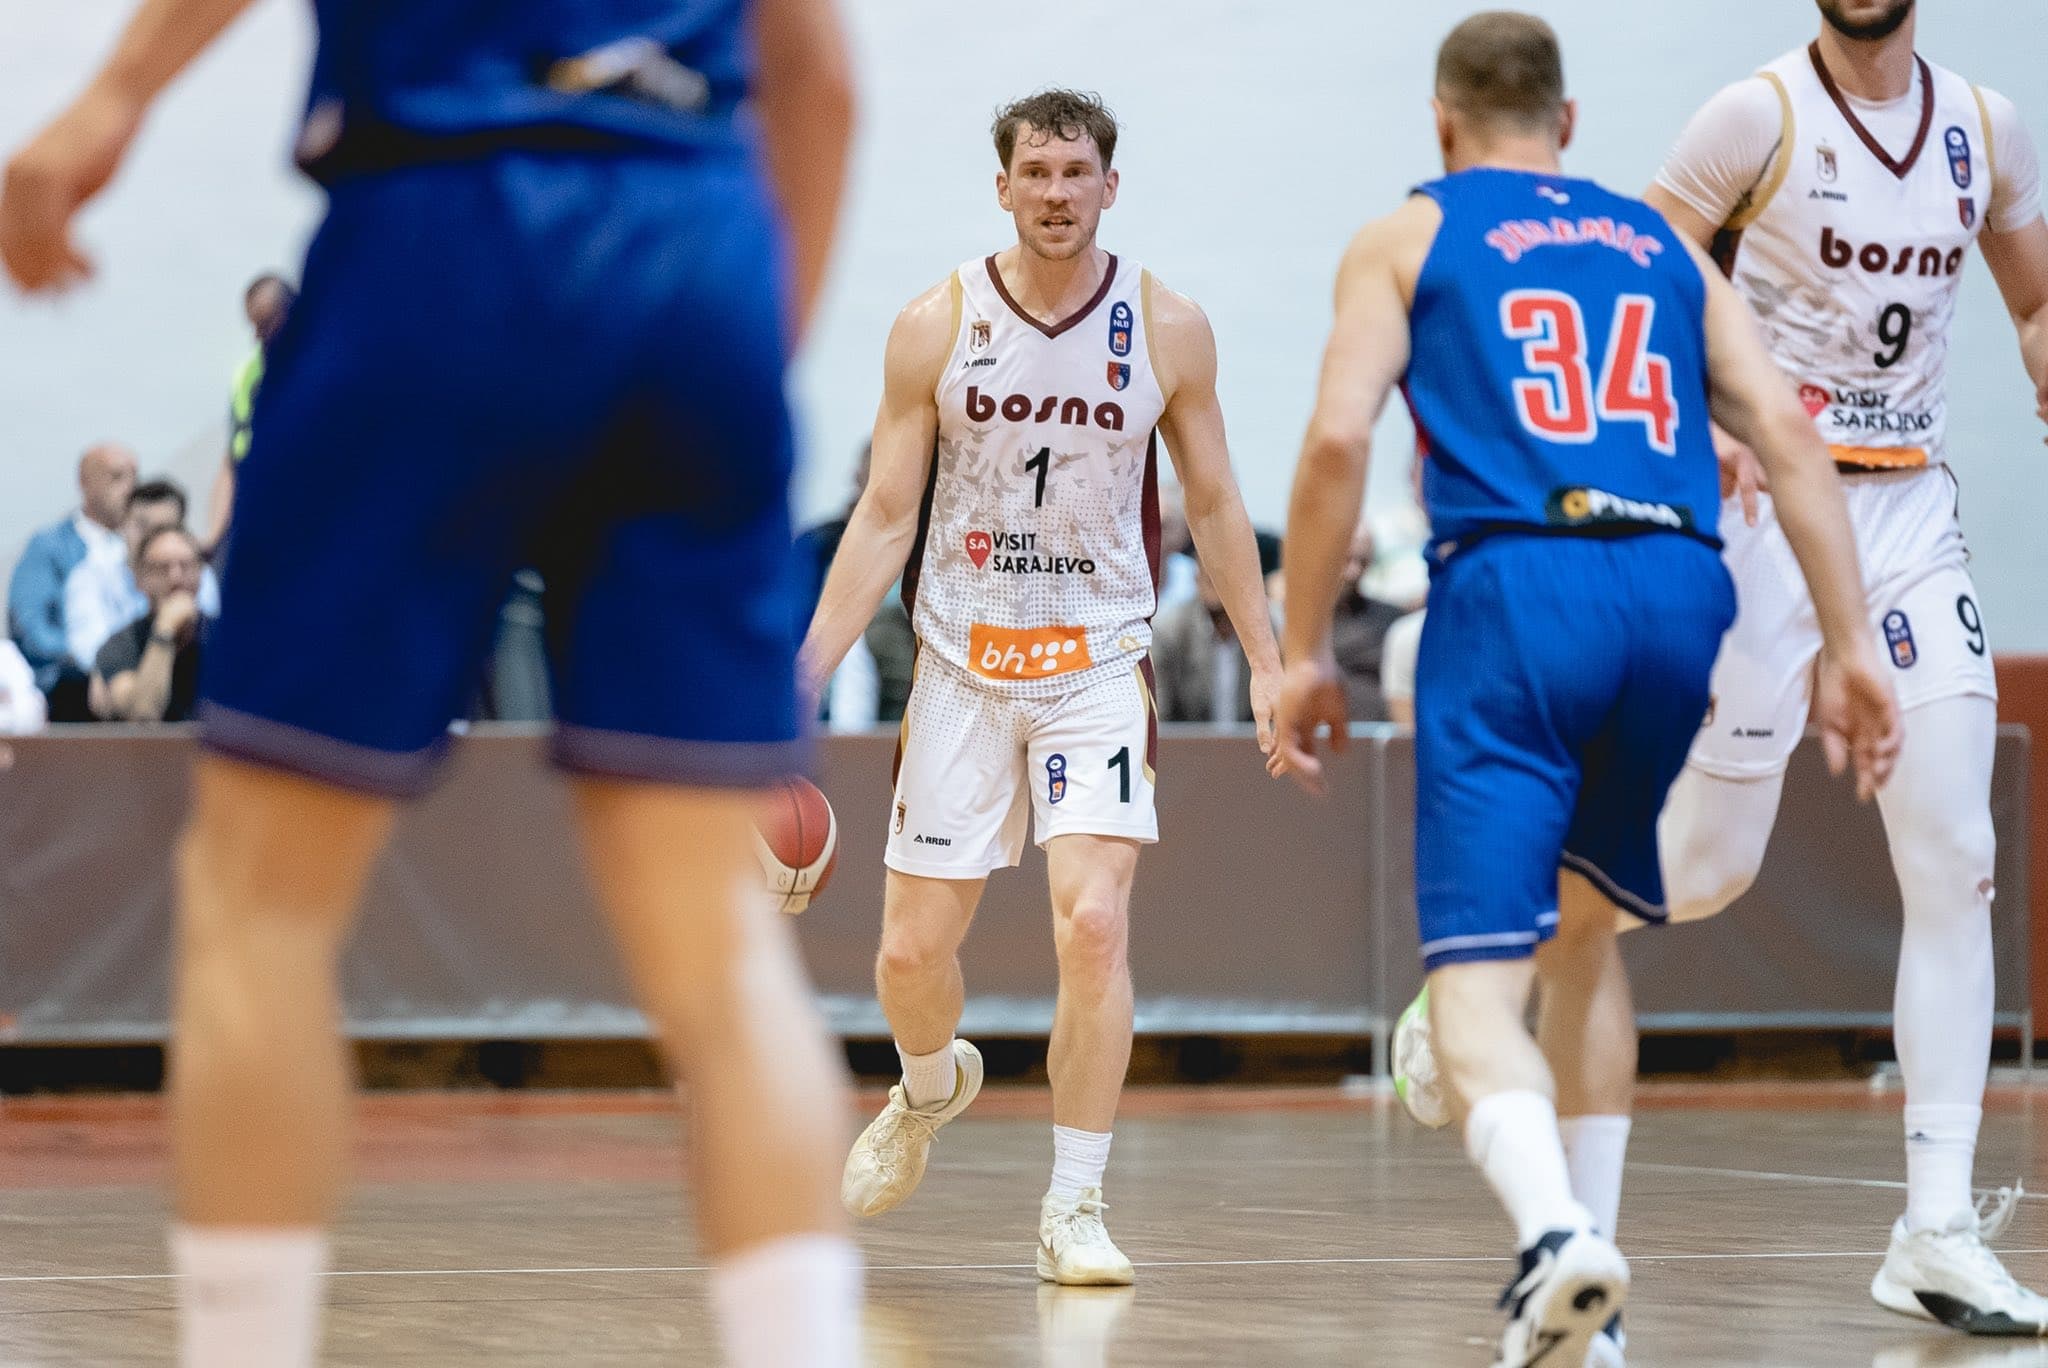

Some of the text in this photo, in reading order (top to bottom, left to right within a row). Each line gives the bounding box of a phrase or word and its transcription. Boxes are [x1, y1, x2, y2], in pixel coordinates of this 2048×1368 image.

[1874, 302, 1912, 369] 9
[1498, 288, 1680, 458] 34
[965, 386, 1125, 432] bosna
[1834, 387, 1891, 408] VISIT
[1025, 447, 1050, 509] 1
[968, 537, 989, 551] SA
[991, 530, 1037, 551] VISIT
[993, 554, 1096, 575] SARAJEVO
[1956, 594, 1985, 657] 9
[980, 640, 1027, 674] bh
[1107, 746, 1131, 803] 1
[925, 835, 951, 847] ARDU
